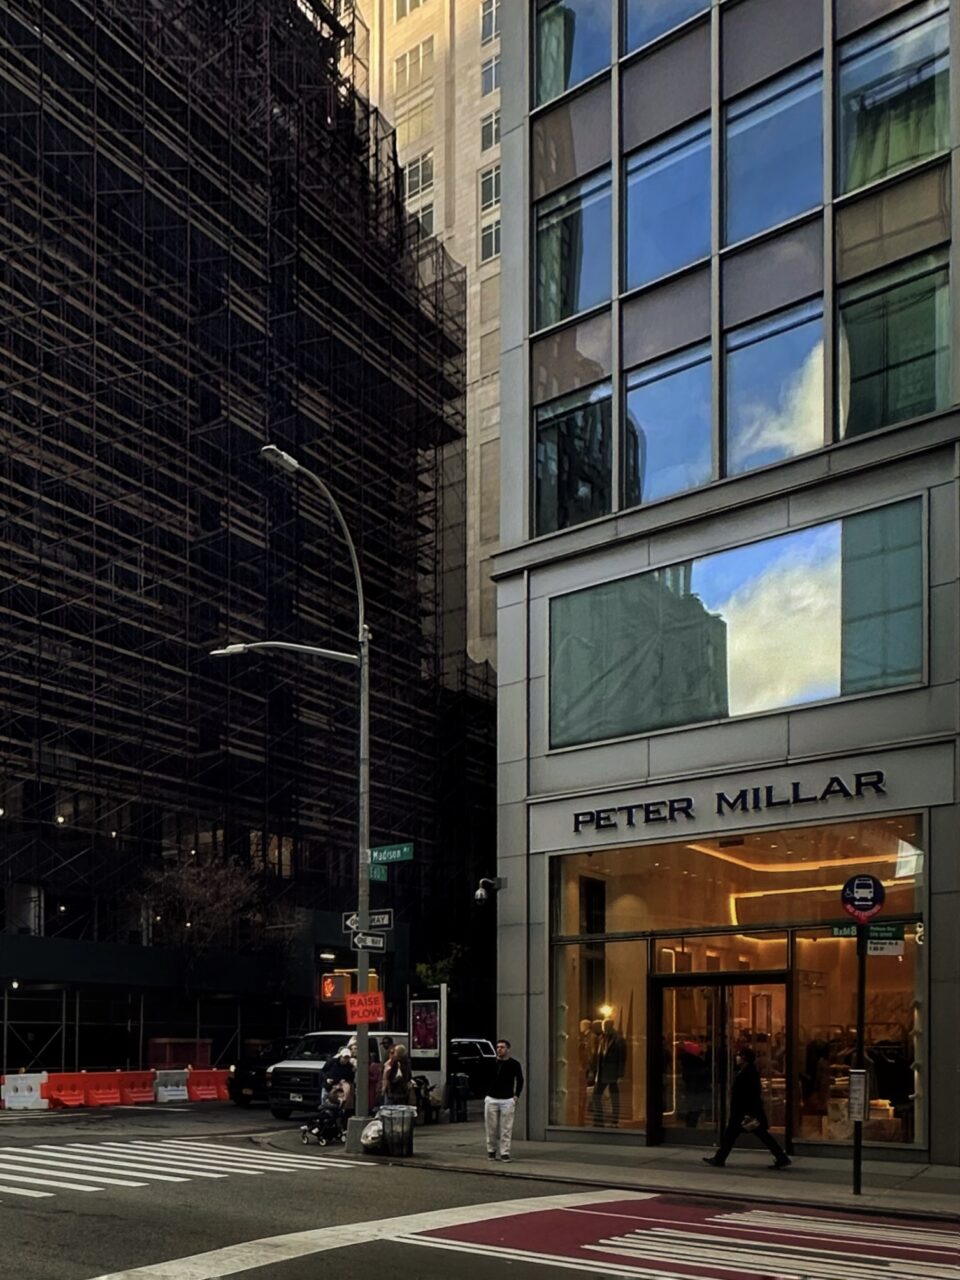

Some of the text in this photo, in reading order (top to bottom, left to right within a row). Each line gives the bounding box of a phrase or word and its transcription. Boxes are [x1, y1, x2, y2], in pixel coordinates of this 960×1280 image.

[573, 770, 887, 833] PETER MILLAR
[373, 849, 401, 862] Madison
[349, 996, 380, 1008] RAISE
[351, 1007, 381, 1019] PLOW
